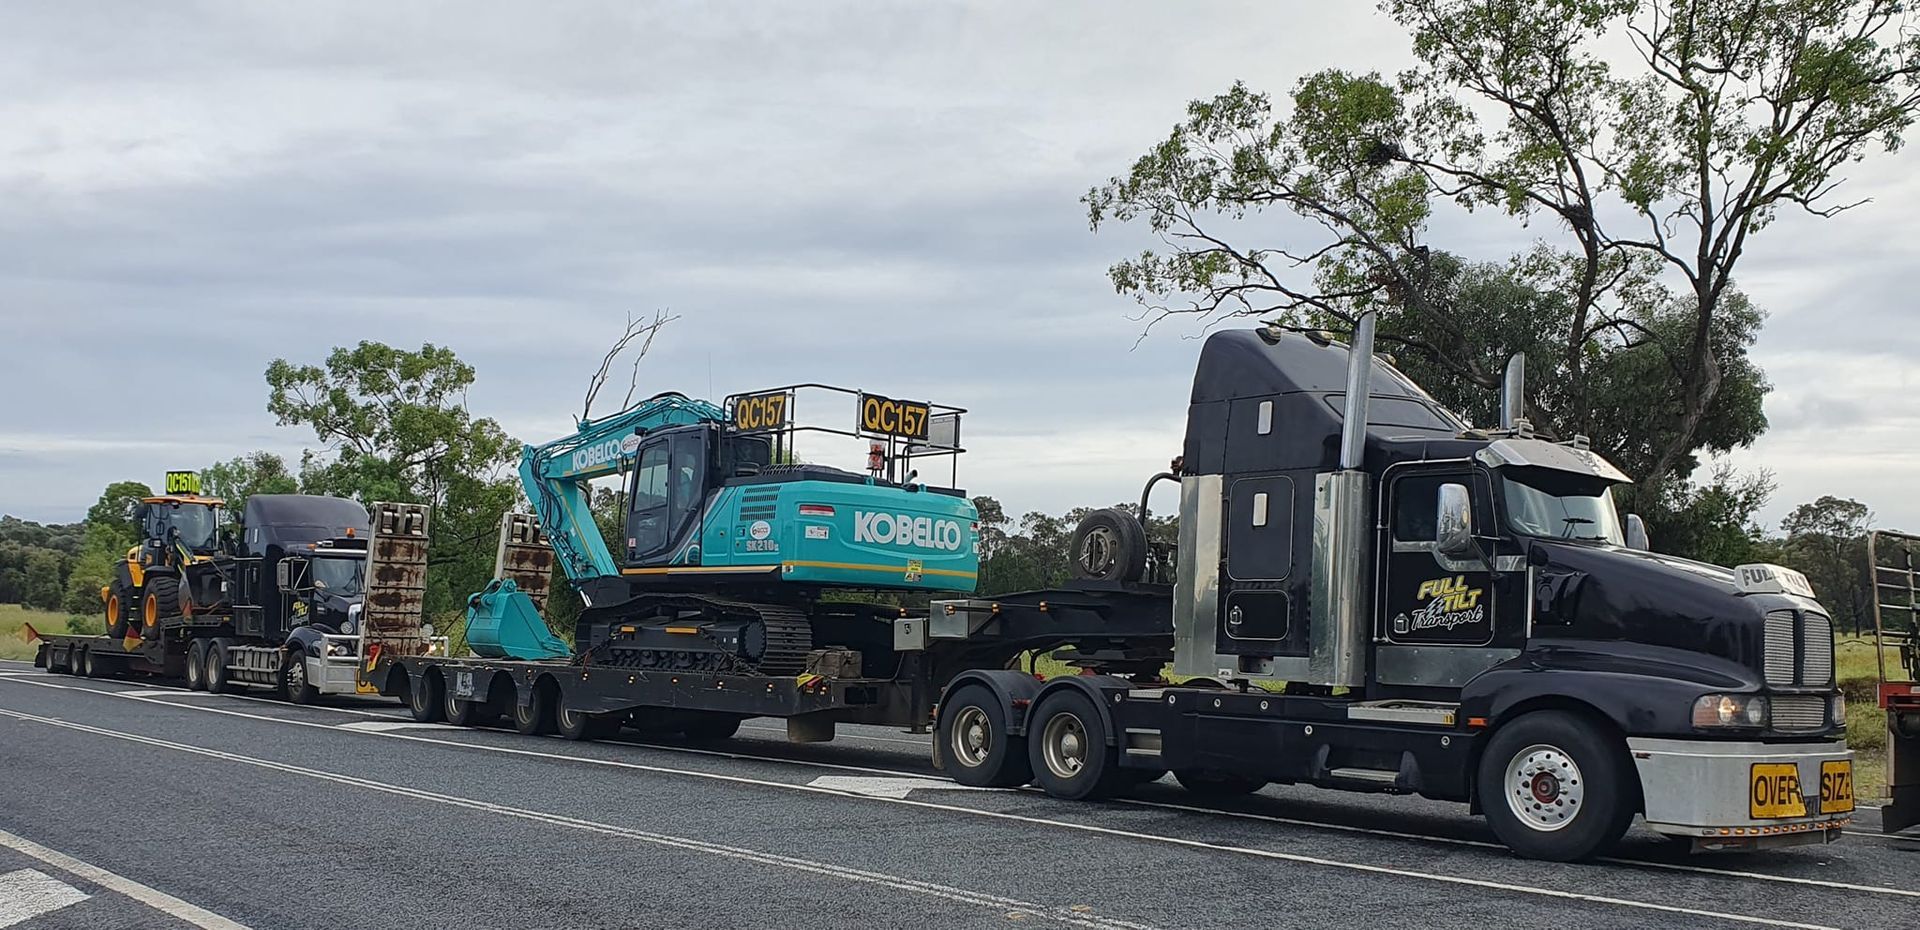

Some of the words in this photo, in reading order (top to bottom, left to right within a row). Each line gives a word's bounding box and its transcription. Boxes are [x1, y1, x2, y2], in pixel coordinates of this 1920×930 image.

[738, 395, 785, 429] QC157
[864, 398, 927, 436] QC157
[572, 439, 620, 472] KOBELCO
[166, 473, 192, 493] QC151
[855, 511, 961, 551] KOBELCO
[1417, 575, 1469, 600] FULL
[1444, 588, 1483, 612] TILT
[1411, 604, 1484, 631] Transport
[1754, 775, 1803, 806] OVER
[1821, 772, 1851, 802] SIZE
